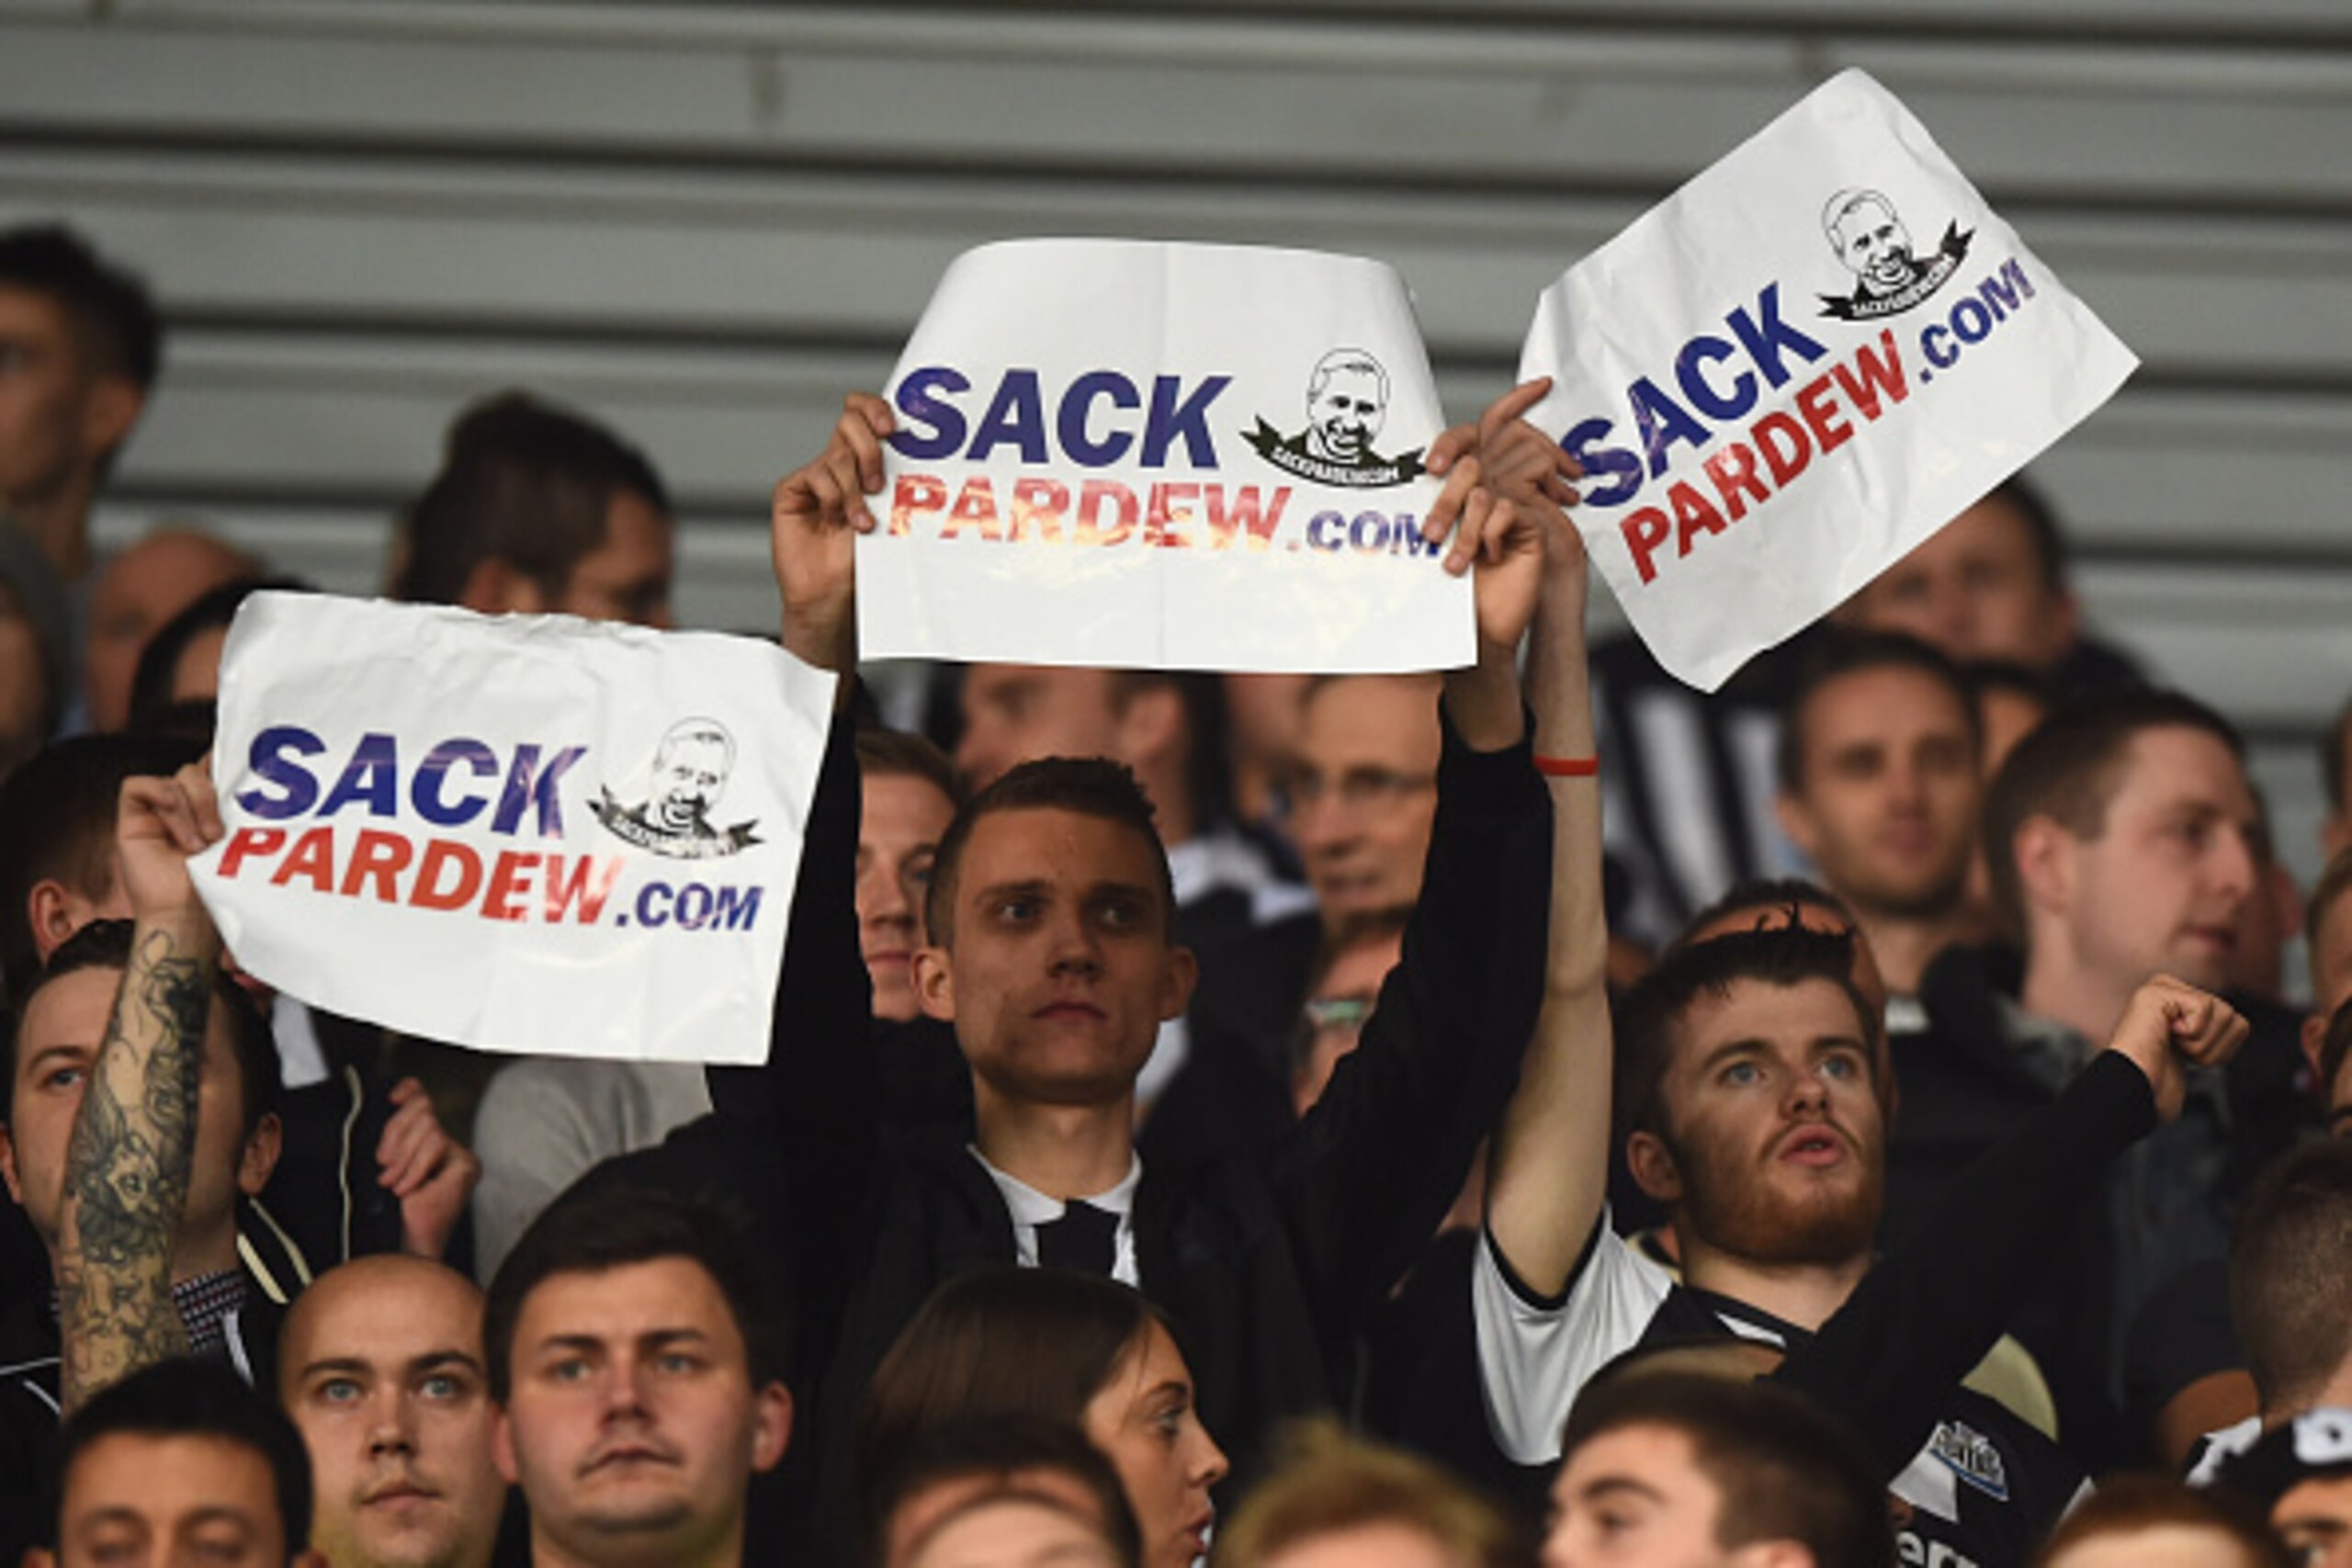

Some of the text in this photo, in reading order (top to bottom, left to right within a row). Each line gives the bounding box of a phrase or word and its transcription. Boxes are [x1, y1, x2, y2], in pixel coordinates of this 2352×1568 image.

[886, 367, 1233, 469] SACK
[1561, 281, 1829, 508] SACK
[235, 725, 588, 837] SACK
